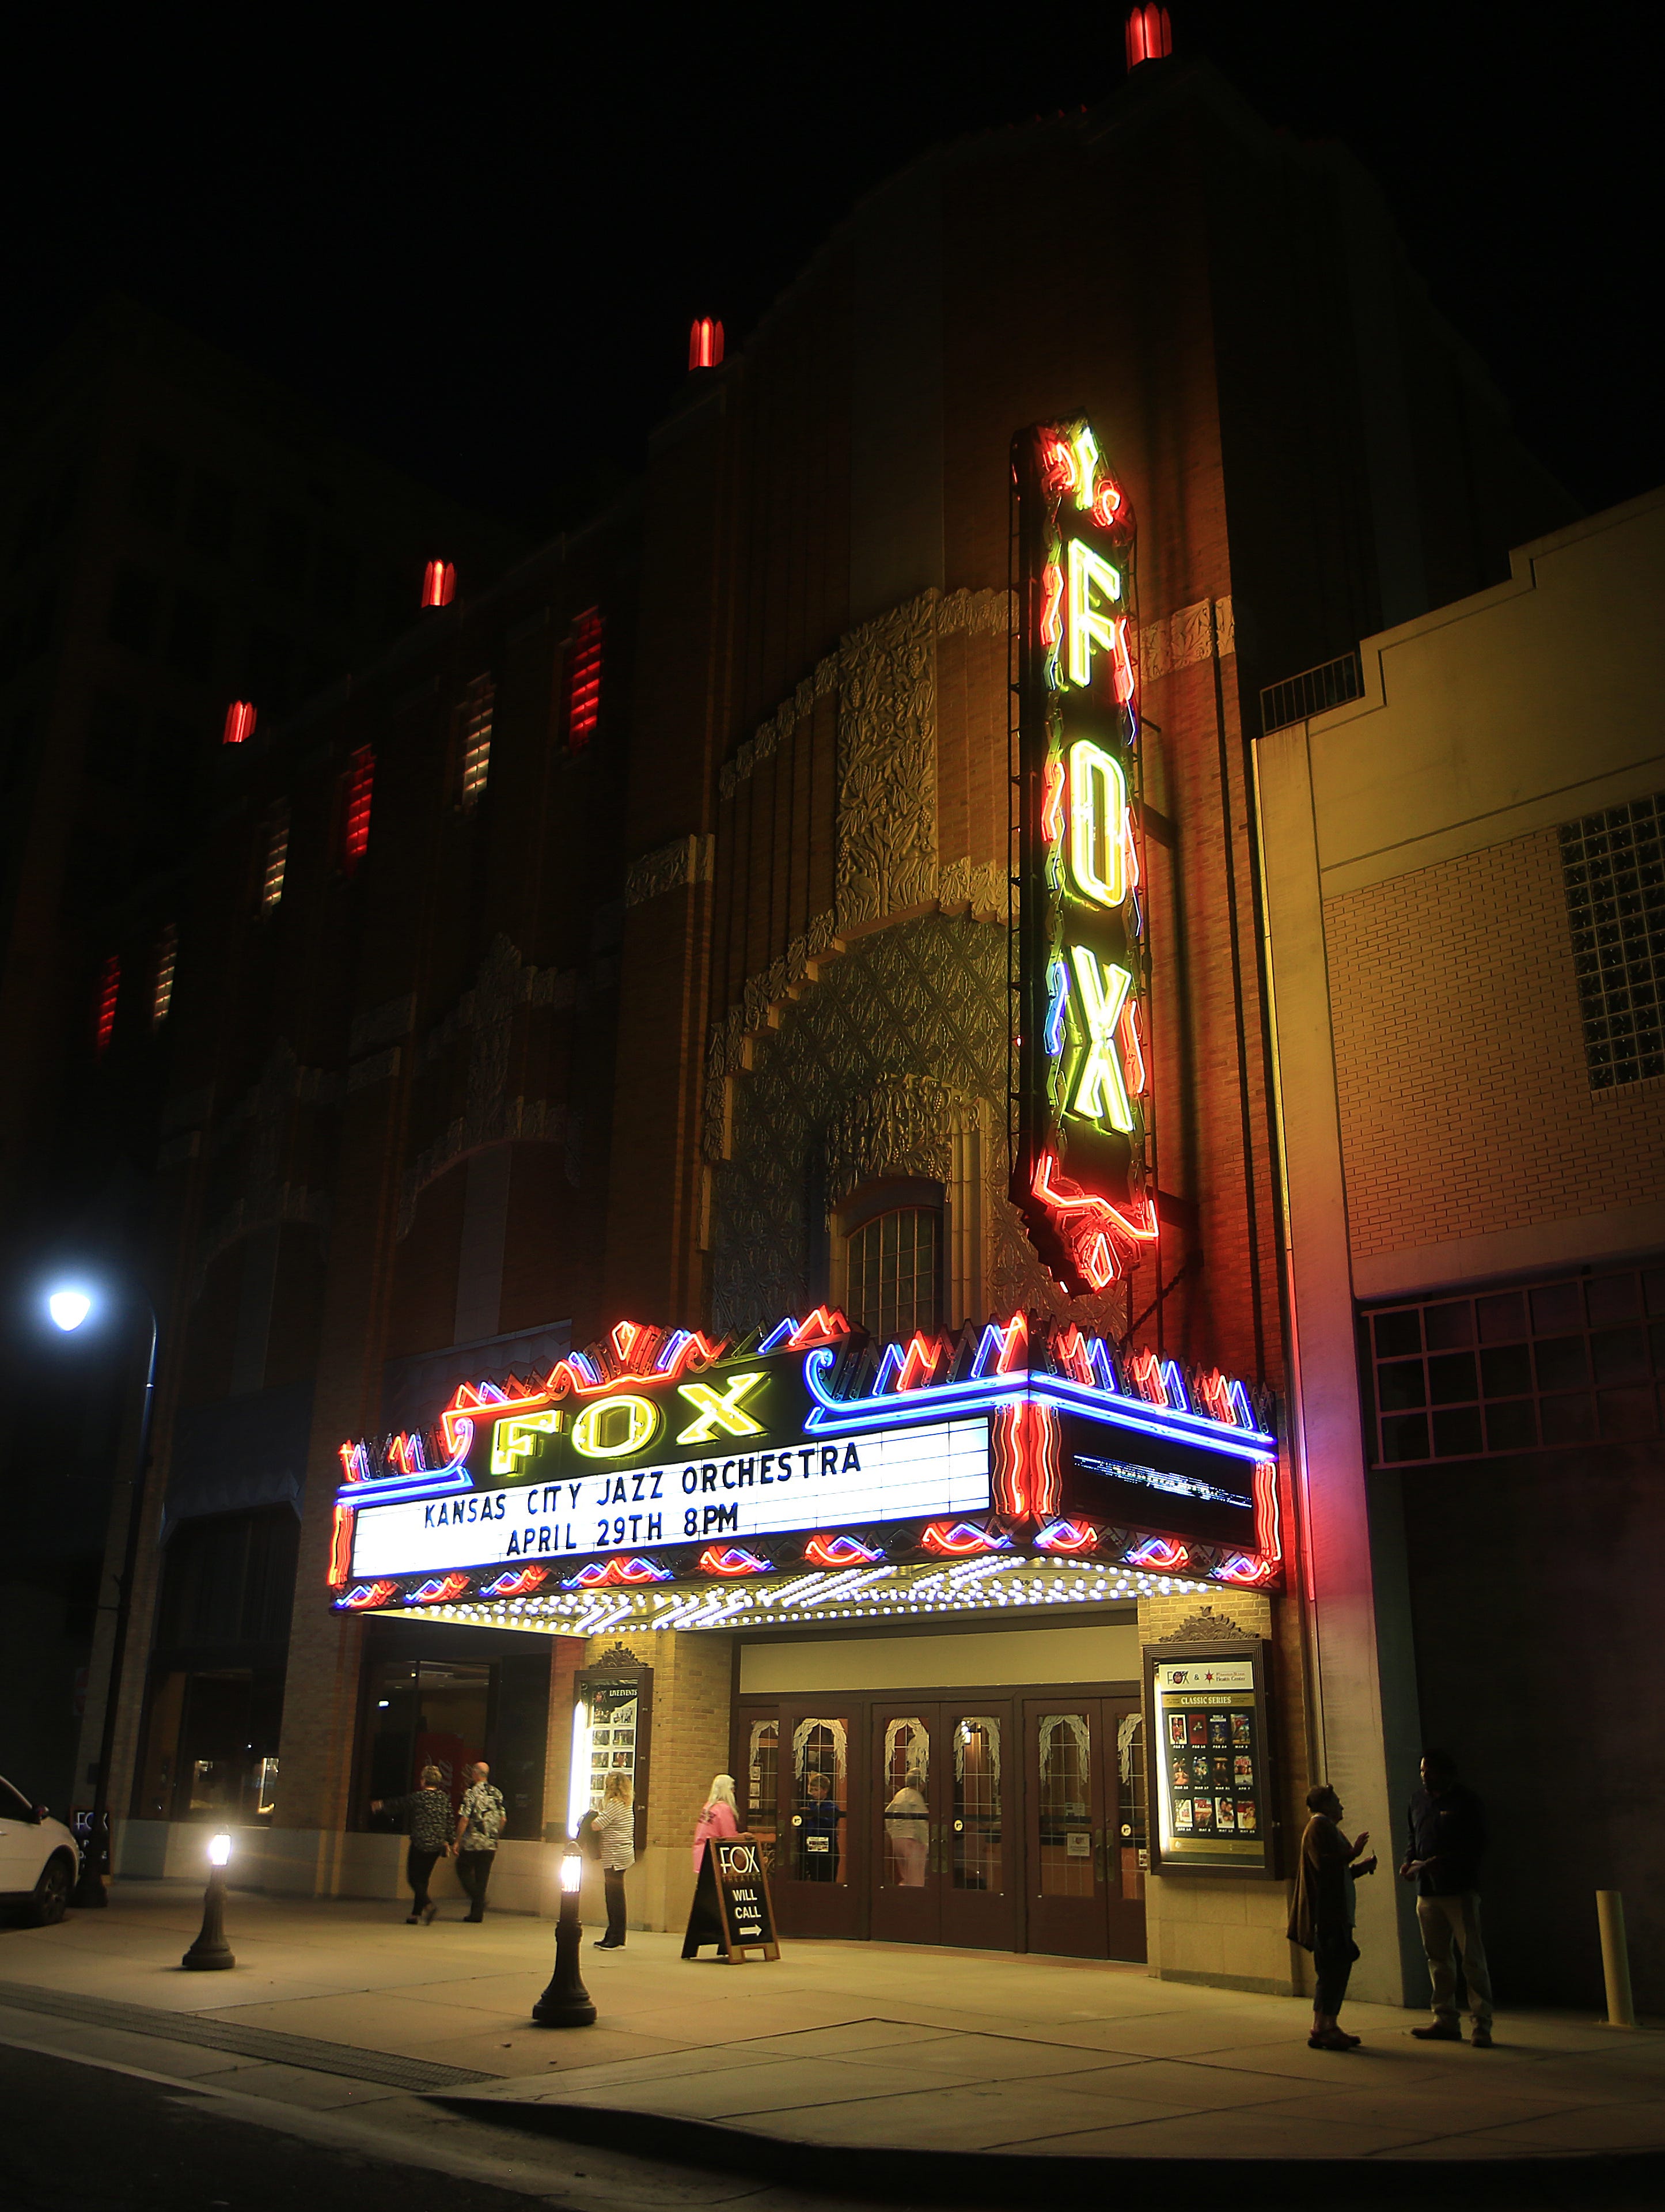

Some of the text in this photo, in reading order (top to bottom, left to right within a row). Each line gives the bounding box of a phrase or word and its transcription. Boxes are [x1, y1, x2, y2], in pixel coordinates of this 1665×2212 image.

[1068, 537, 1133, 1135] FOX
[490, 1371, 771, 1475] FOX
[425, 1442, 861, 1528] KANSAS CITY JAZZ ORCHESTRA
[507, 1502, 738, 1556] APRIL 29TH 8PM
[1167, 1671, 1189, 1685] FOX
[1181, 1696, 1207, 1705] CLASSIC
[1208, 1696, 1231, 1705] SERIES
[720, 1846, 760, 1873] FOX
[732, 1889, 757, 1901] WILL
[735, 1906, 761, 1919] CALL
